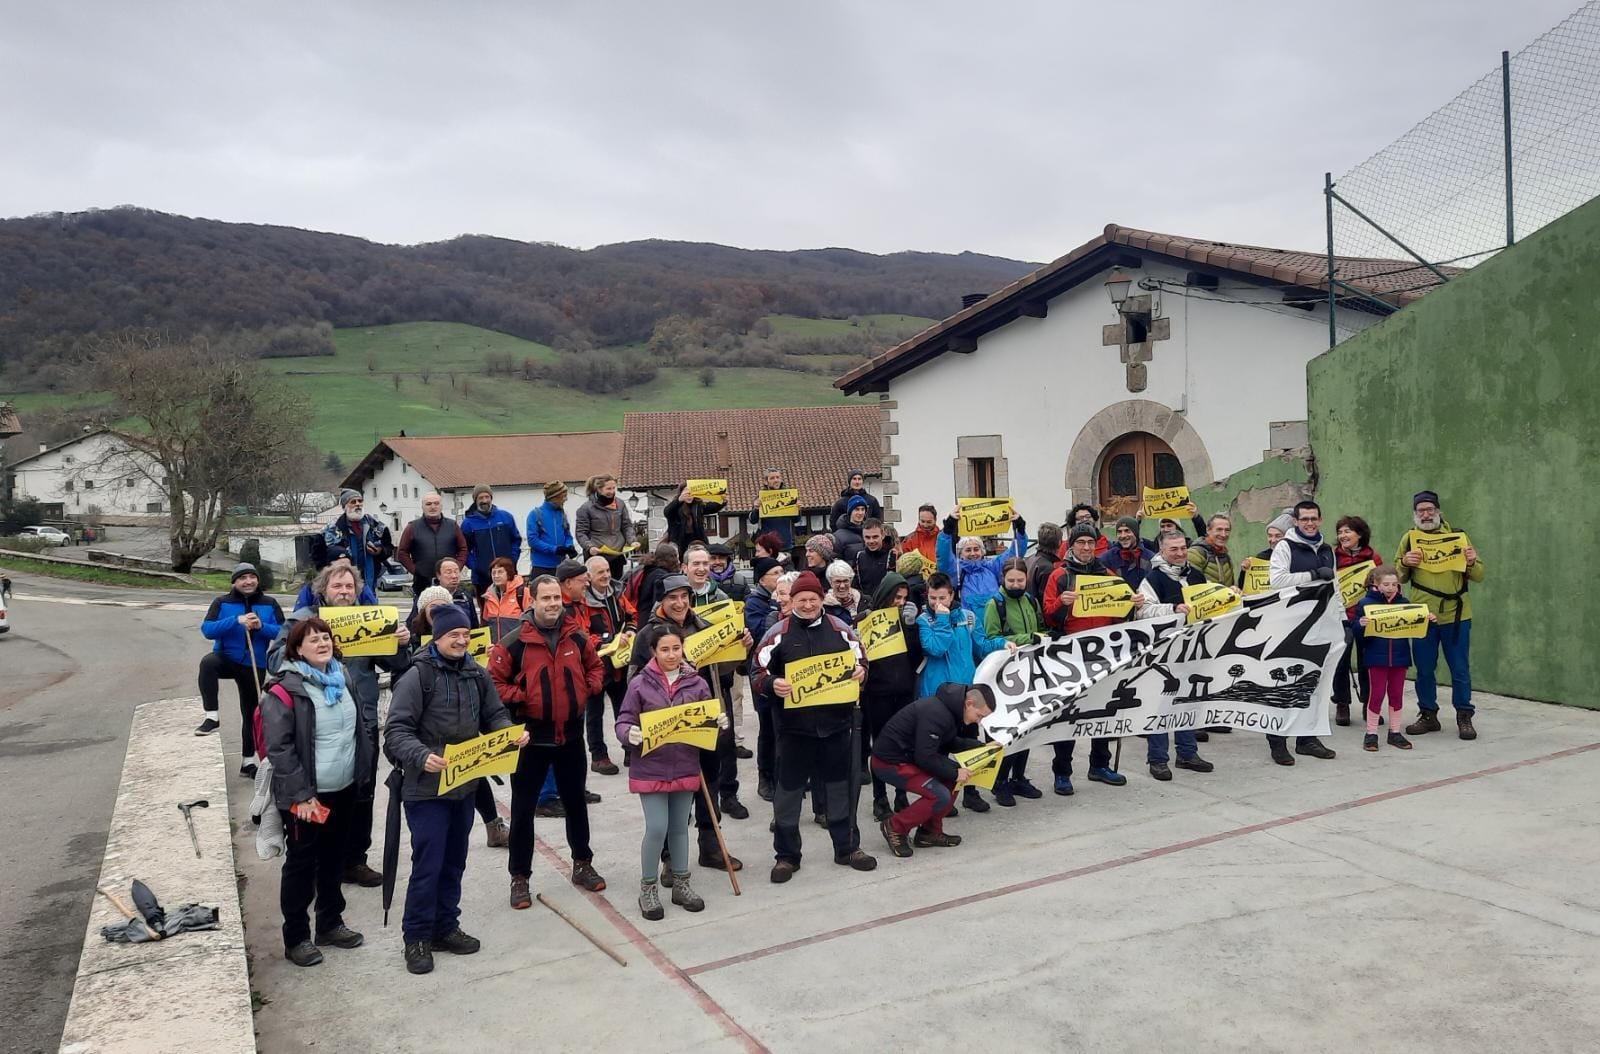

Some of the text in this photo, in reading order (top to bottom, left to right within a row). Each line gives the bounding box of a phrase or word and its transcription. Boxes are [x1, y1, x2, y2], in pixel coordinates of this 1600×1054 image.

[1165, 490, 1180, 500] EZ!
[362, 608, 385, 622] EZ!
[871, 611, 888, 627] EZ!
[717, 621, 736, 640] EZ!
[824, 655, 845, 670] EZ!
[684, 704, 707, 717] EZ!
[1072, 718, 1133, 737] ARALAR
[1204, 709, 1284, 731] DEZAGUN
[488, 731, 510, 748] EZ!
